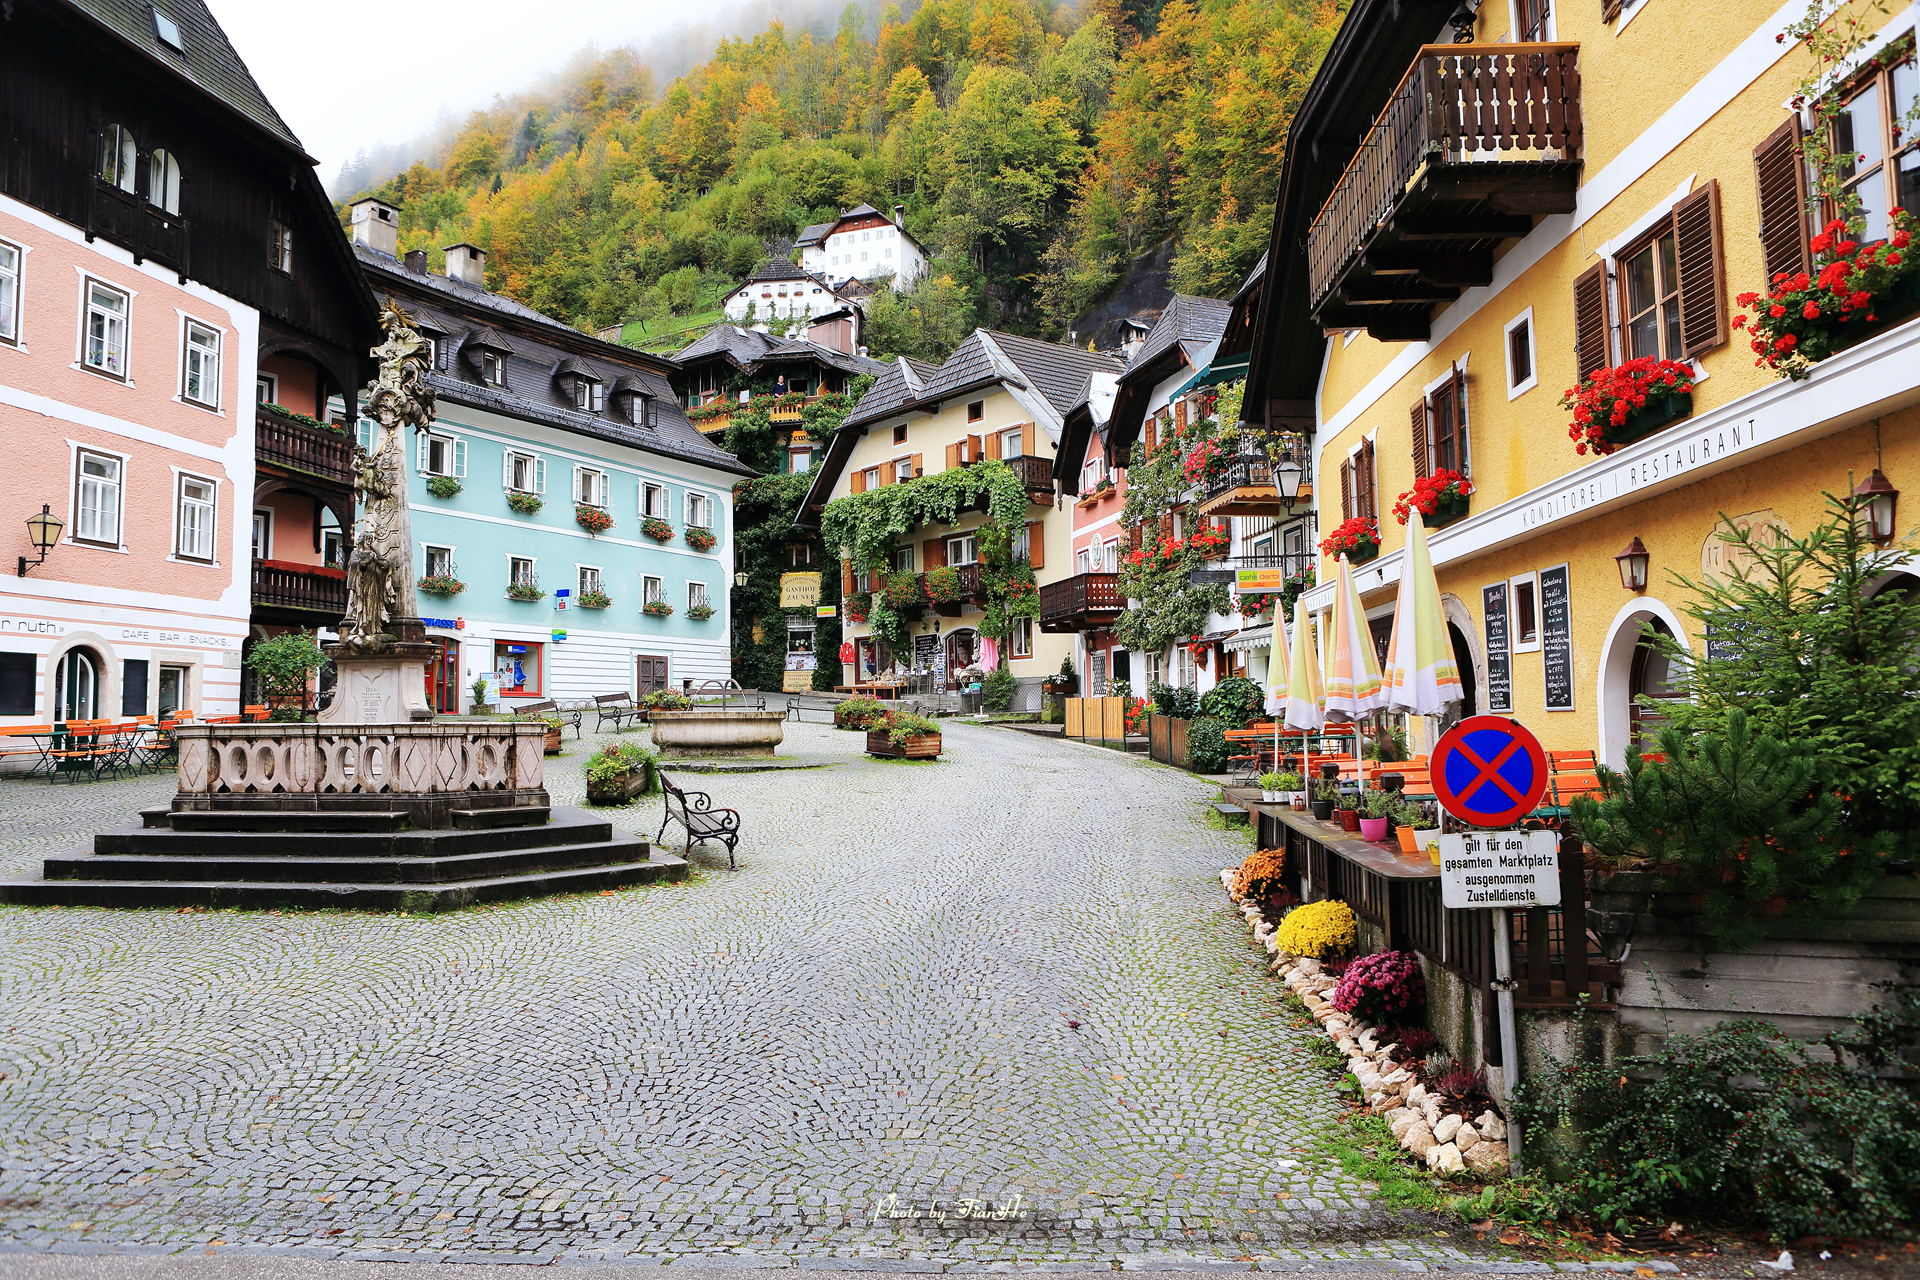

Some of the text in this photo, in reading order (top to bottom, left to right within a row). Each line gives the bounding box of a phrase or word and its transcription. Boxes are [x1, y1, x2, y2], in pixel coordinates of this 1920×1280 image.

[1522, 418, 1756, 528] KONDITOREI RESTAURANT
[121, 629, 227, 647] CAFÉ BAR SNACKS
[1465, 838, 1523, 855] gilt für den
[1445, 854, 1553, 872] gesamten Marktplatz
[1465, 873, 1535, 887] ausgenommen
[1466, 889, 1535, 902] Zustelldienste
